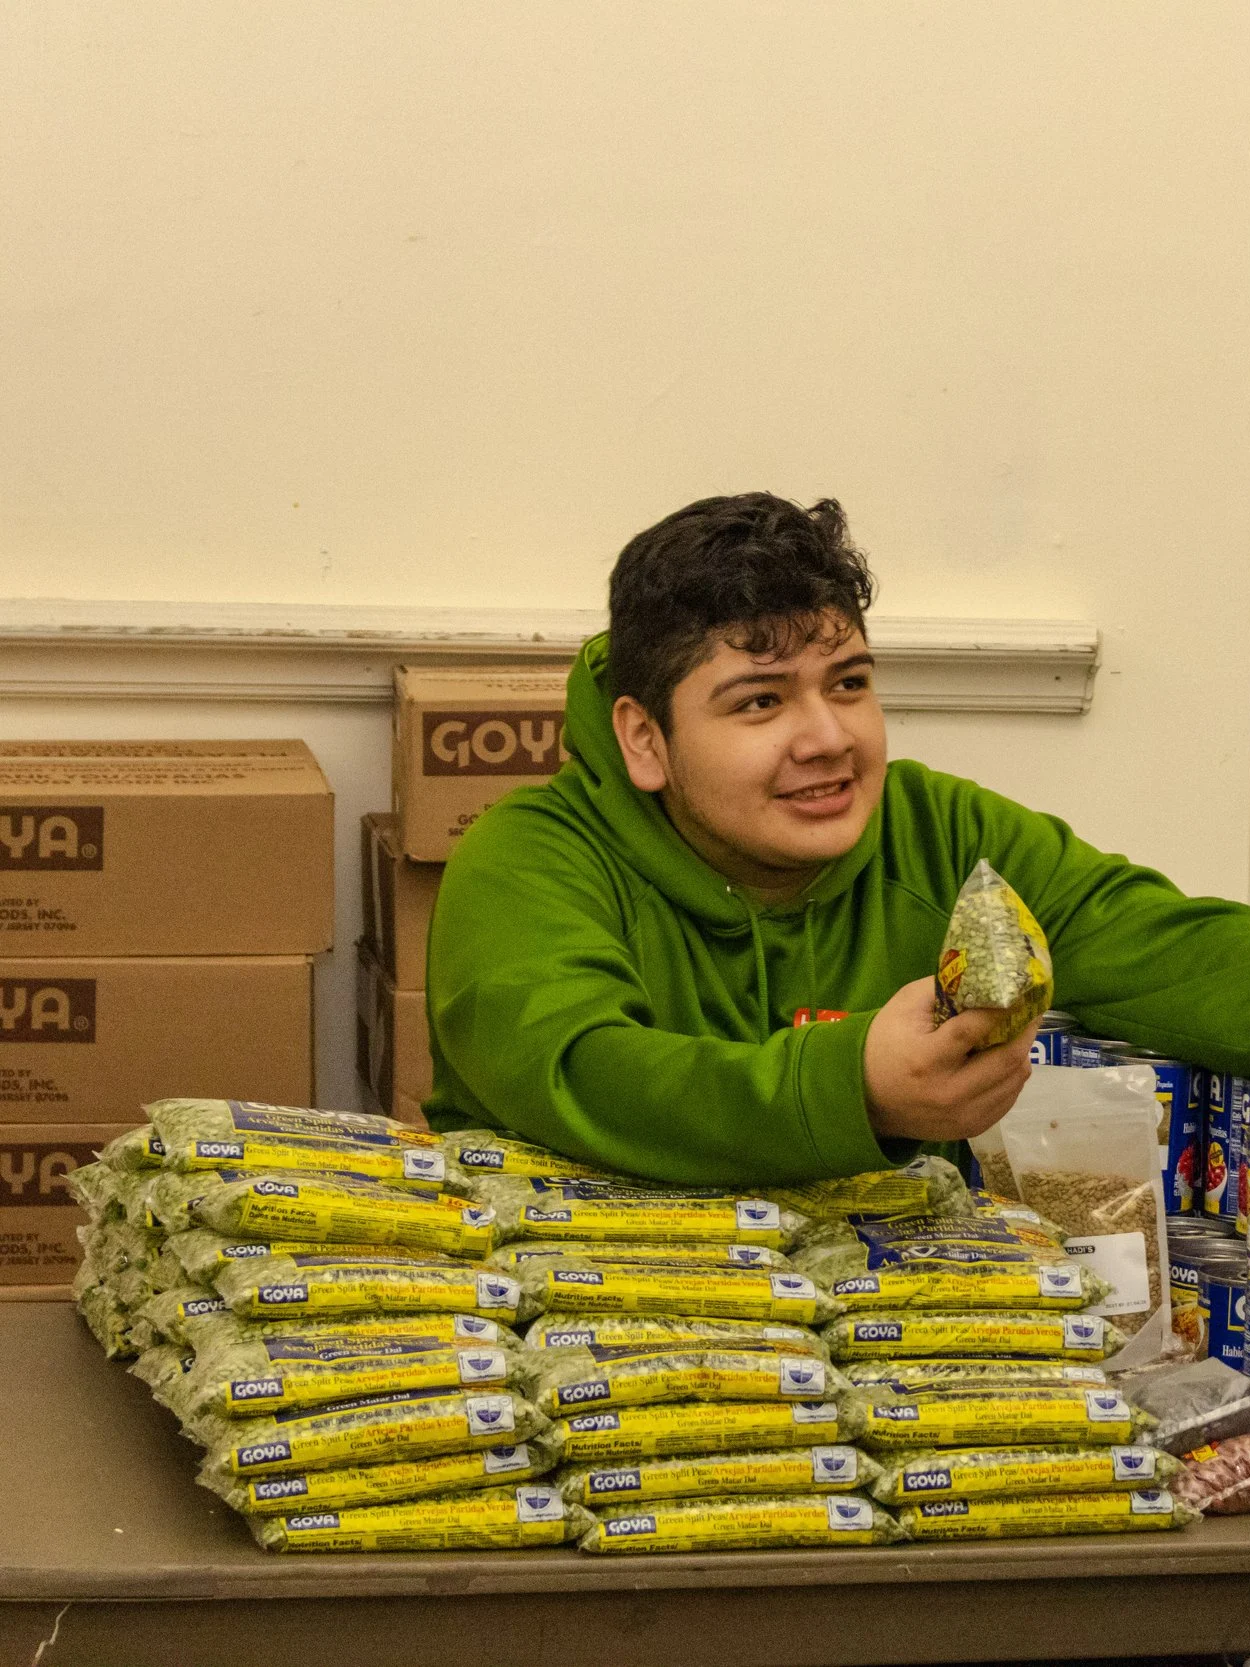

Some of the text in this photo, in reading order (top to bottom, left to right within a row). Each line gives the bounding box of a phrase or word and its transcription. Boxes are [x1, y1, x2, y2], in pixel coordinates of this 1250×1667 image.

[430, 720, 570, 768] GOY
[0, 815, 78, 859] YA
[0, 987, 70, 1030] YA
[200, 1143, 241, 1156] GOYA
[463, 1151, 501, 1165] GOYA
[2, 1151, 79, 1195] YA
[257, 1181, 296, 1194] GOYA
[225, 1245, 267, 1257] GOYA
[558, 1271, 600, 1283] GOYA
[263, 1287, 305, 1301] GOYA
[836, 1279, 877, 1293] GOYA
[550, 1333, 592, 1346] GOYA
[858, 1325, 898, 1339] GOYA
[904, 1325, 928, 1335] Green
[930, 1325, 948, 1337] Split
[1002, 1326, 1033, 1336] Partidas
[234, 1380, 281, 1398] GOYA
[563, 1384, 606, 1400] GOYA
[327, 1401, 356, 1411] Green
[392, 1393, 410, 1403] Dal
[573, 1414, 616, 1430] GOYA
[241, 1444, 287, 1463] GOYA
[594, 1474, 639, 1490] GOYA
[643, 1470, 668, 1481] Green
[747, 1463, 781, 1475] Partidas
[907, 1473, 949, 1488] GOYA
[953, 1469, 977, 1480] Green
[979, 1467, 997, 1480] Split
[1051, 1462, 1084, 1473] Partidas
[1085, 1461, 1111, 1471] Verdes
[258, 1479, 305, 1497] GOYA
[924, 1501, 965, 1515] GOYA
[290, 1514, 339, 1528] GOYA
[608, 1518, 652, 1534] GOYA
[761, 1510, 794, 1520] Partidas
